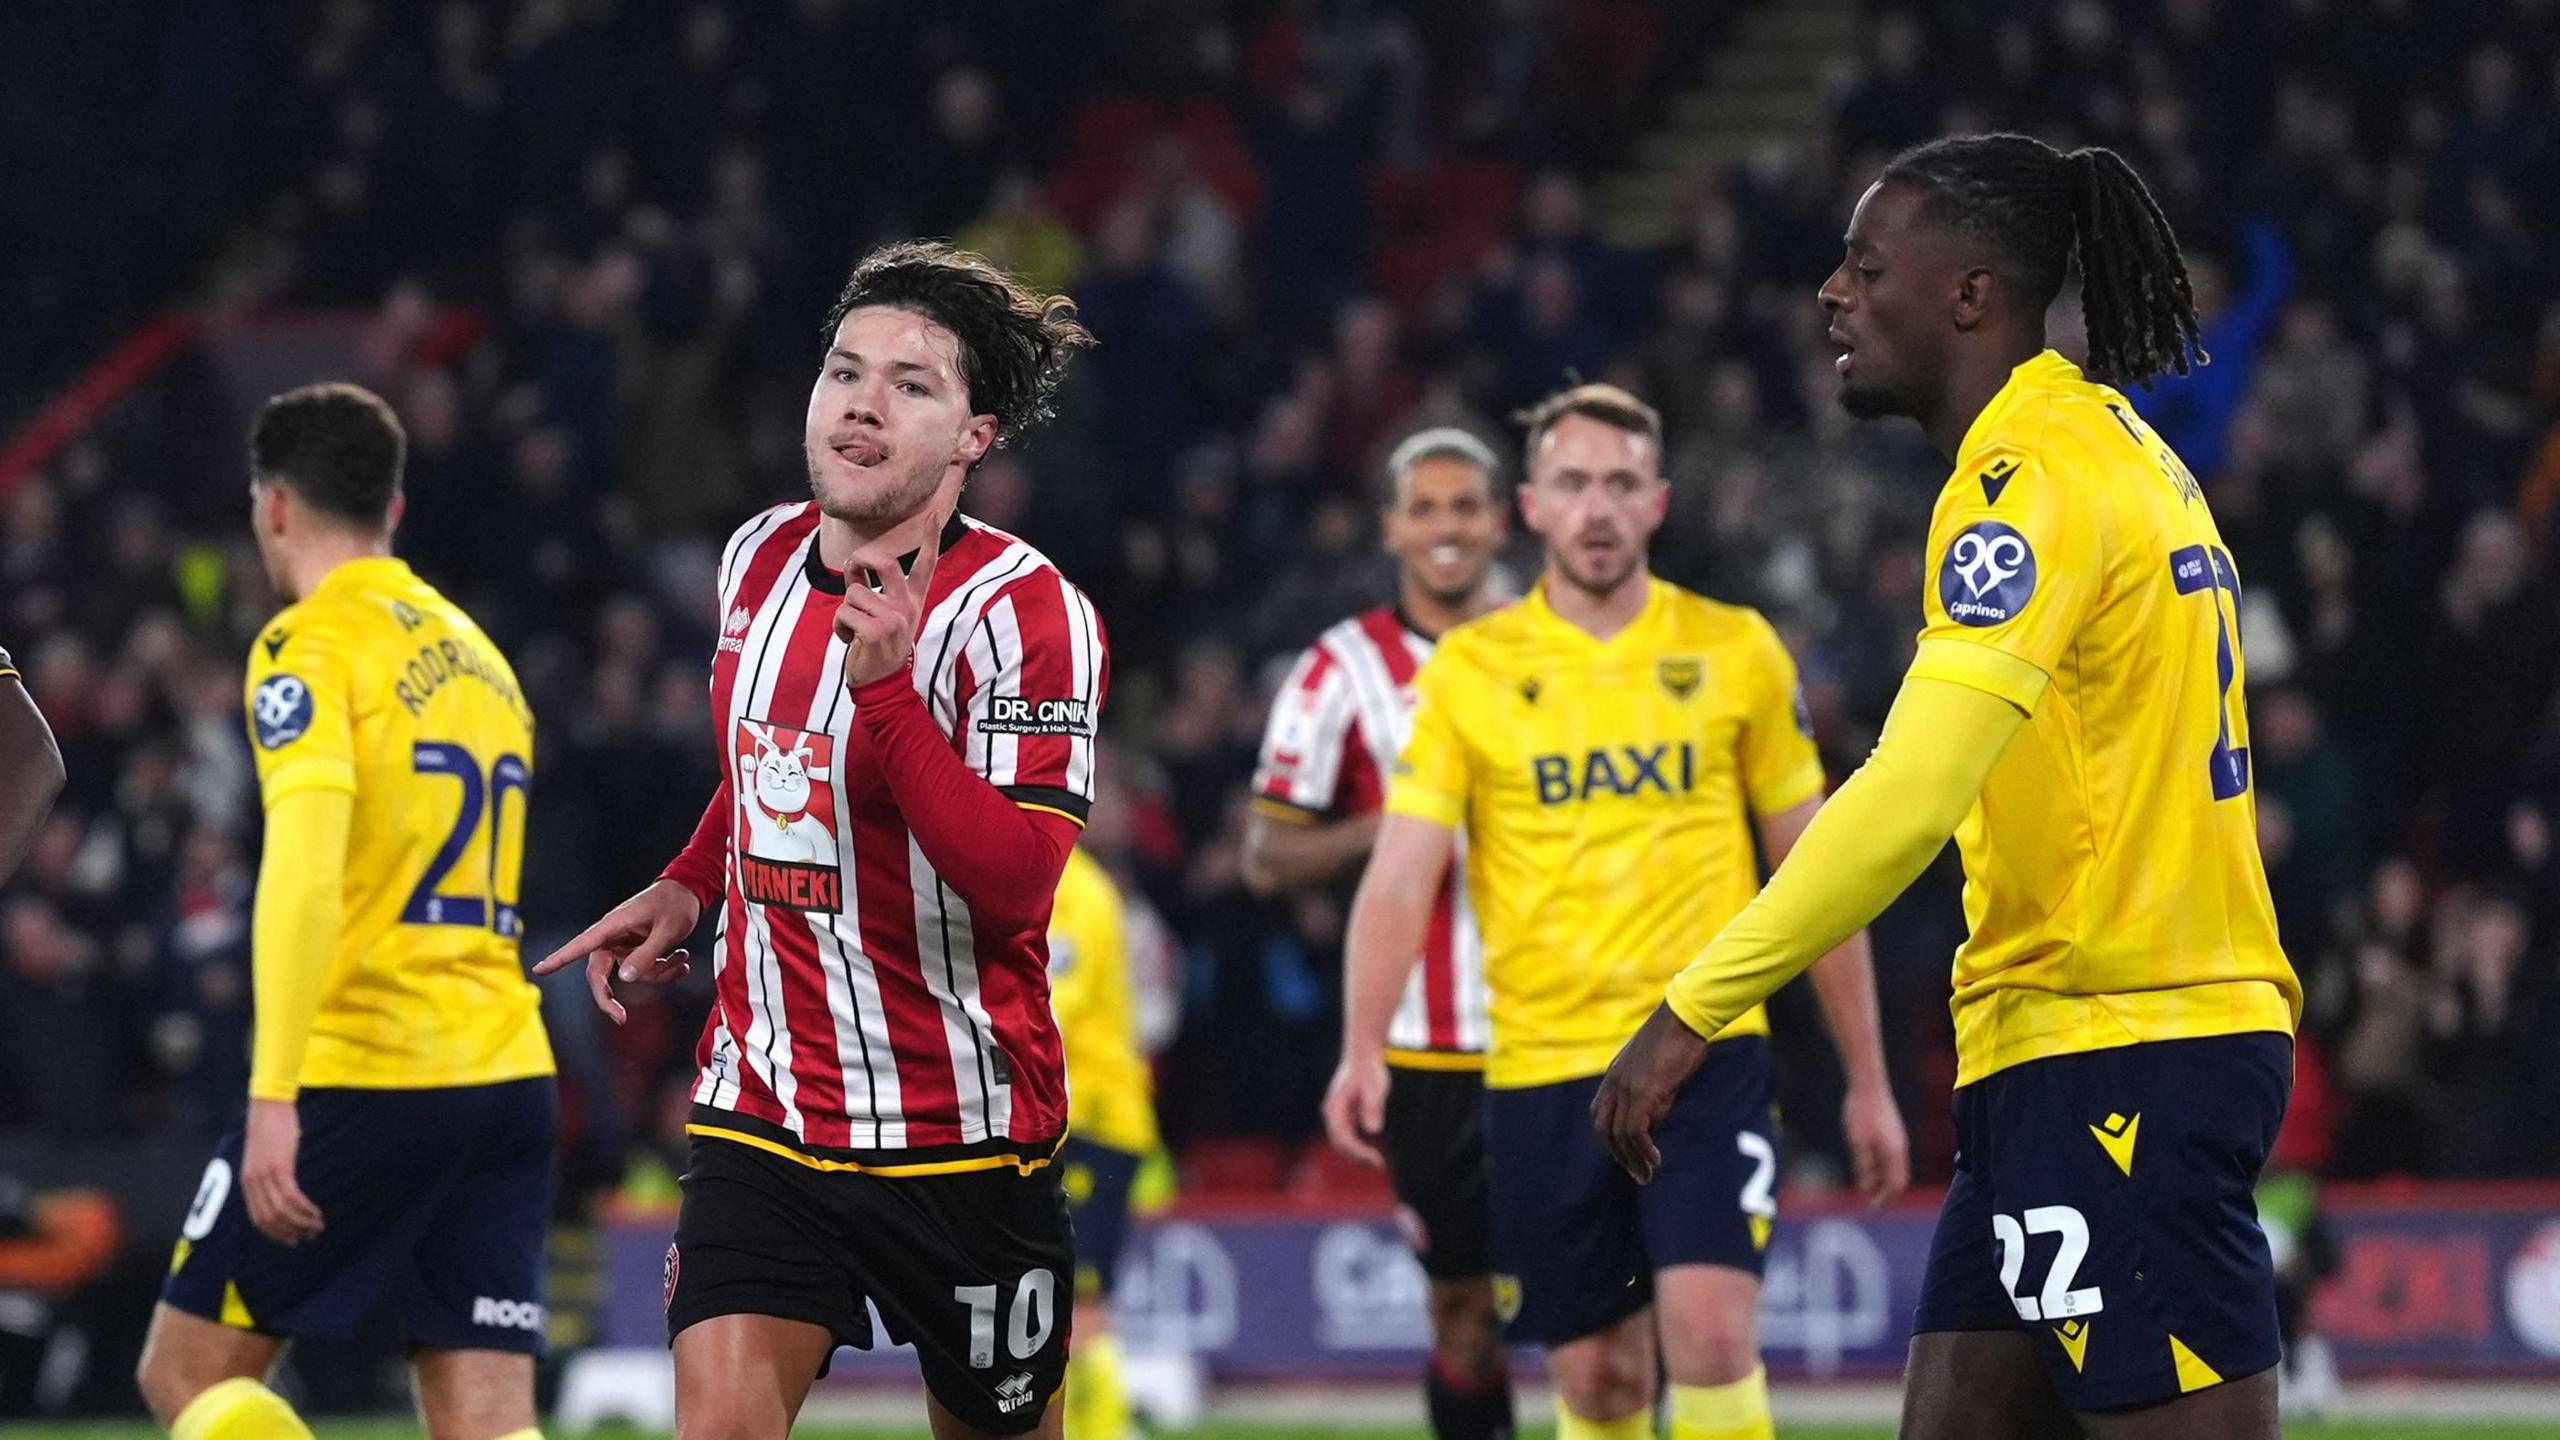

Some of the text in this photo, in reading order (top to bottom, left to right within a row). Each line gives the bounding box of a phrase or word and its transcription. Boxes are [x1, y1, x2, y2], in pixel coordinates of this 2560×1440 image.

[1950, 601, 2006, 619] Caprinos
[979, 722, 1008, 732] Plastic
[1008, 723, 1041, 734] Surgery
[1041, 724, 1049, 733] &
[1049, 724, 1068, 733] Hair
[993, 699, 1034, 721] DR.
[1535, 742, 1694, 804] BAXI
[399, 741, 532, 936] 20
[742, 857, 839, 911] MANEKI
[1735, 1130, 1777, 1216] 2
[1992, 1204, 2104, 1321] 22
[954, 1267, 1055, 1369] 10
